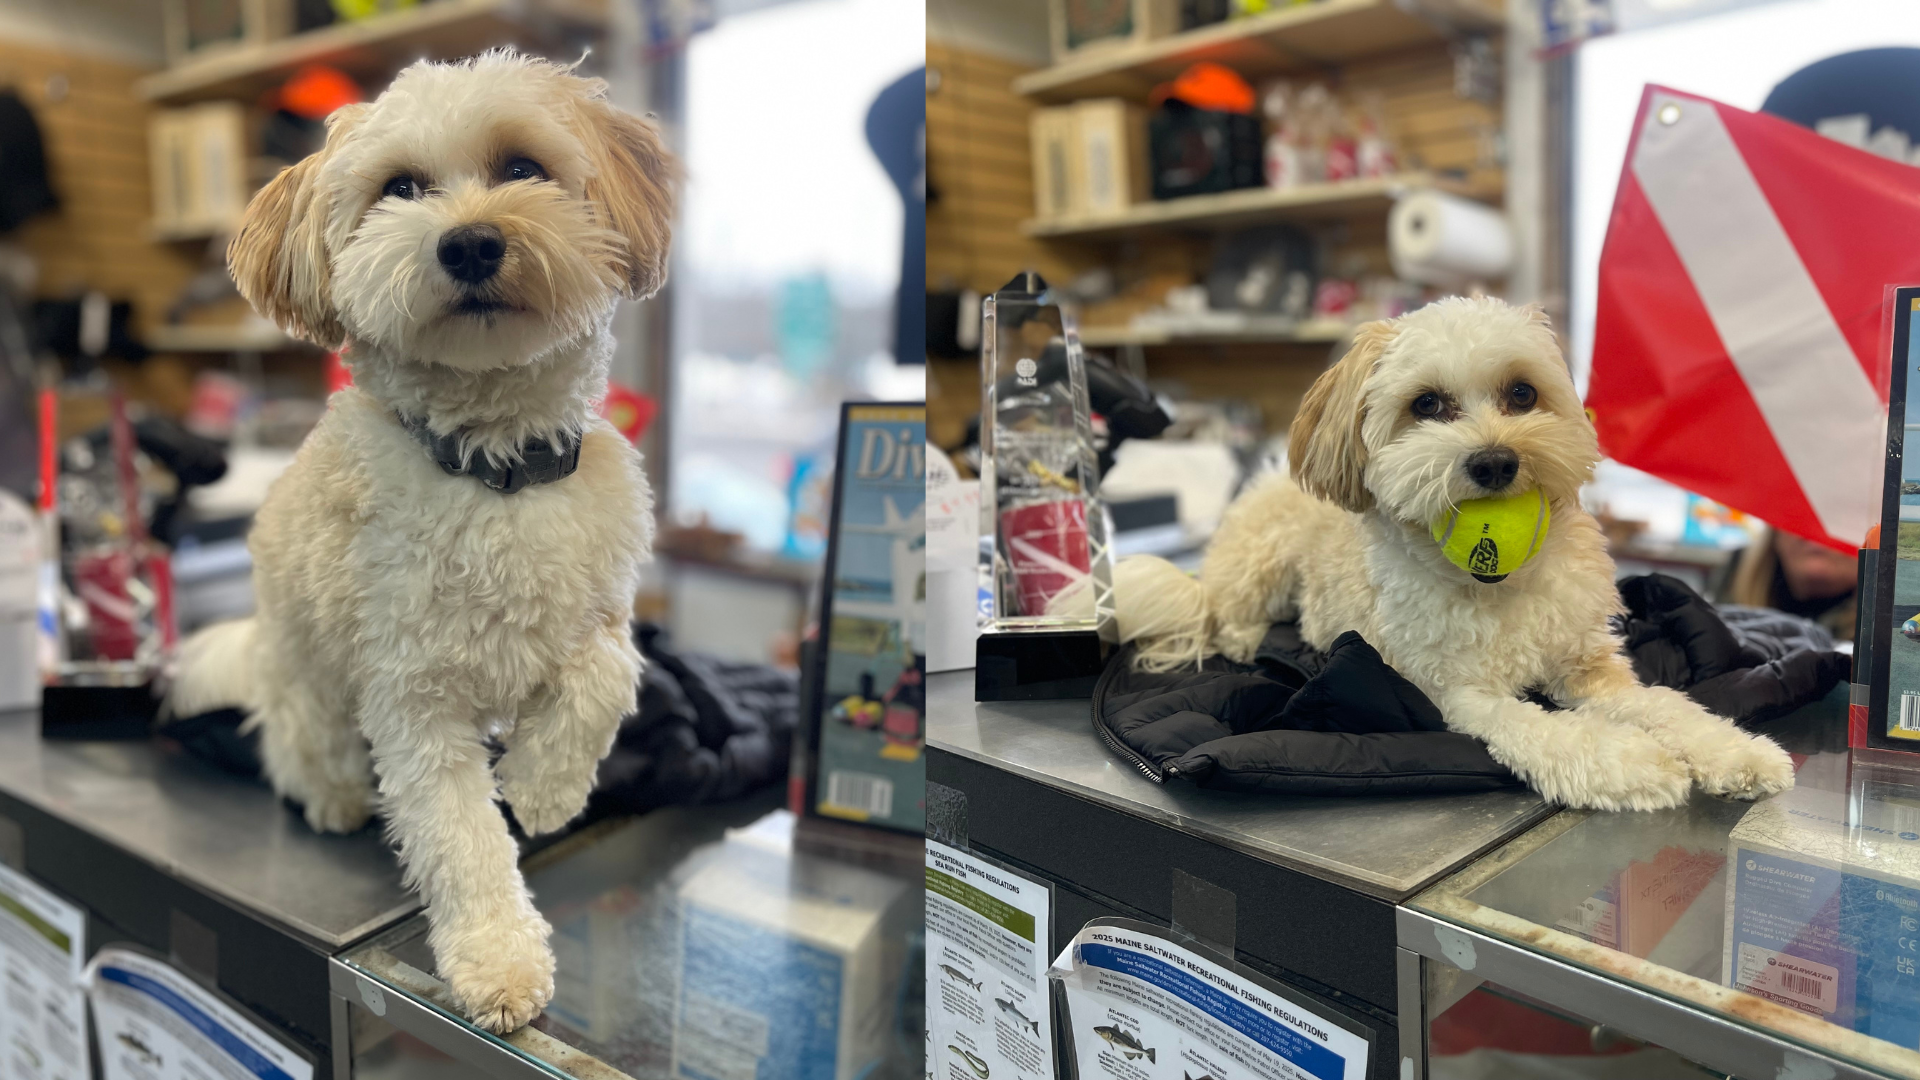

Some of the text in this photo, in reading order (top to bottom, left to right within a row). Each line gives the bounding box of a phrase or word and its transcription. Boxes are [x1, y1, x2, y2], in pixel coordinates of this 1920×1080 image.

[930, 850, 1020, 895] RECREATIONAL FISHING REGULATIONS
[935, 860, 966, 878] SEA RUN FISH
[1758, 864, 1816, 884] SHEARWATER
[1783, 882, 1812, 894] Computer
[1885, 893, 1917, 908] Bluetooth
[1778, 961, 1832, 982] SHEARWATER
[1897, 956, 1915, 967] UK
[1897, 965, 1915, 976] CA
[1092, 934, 1328, 1043] 2025 MAINE SALTWATER RECREATIONAL FISHING REGULATIONS
[1100, 979, 1111, 987] they
[1123, 985, 1140, 998] subject
[1148, 996, 1165, 1009] change.
[1117, 957, 1134, 966] Maine
[1135, 962, 1159, 976] Saltwater
[1160, 972, 1189, 991] Recreational
[1190, 987, 1206, 1001] Fishing
[1236, 1012, 1247, 1023] learn
[1248, 1020, 1259, 1030] more
[1736, 983, 1768, 997] Johnson's
[1770, 994, 1798, 1007] Sporting
[1176, 1019, 1185, 1028] NOT
[1258, 1018, 1267, 1027] you
[1274, 1025, 1291, 1041] register
[1292, 1036, 1302, 1046] with
[1304, 1042, 1312, 1051] the
[1263, 1052, 1272, 1063] May
